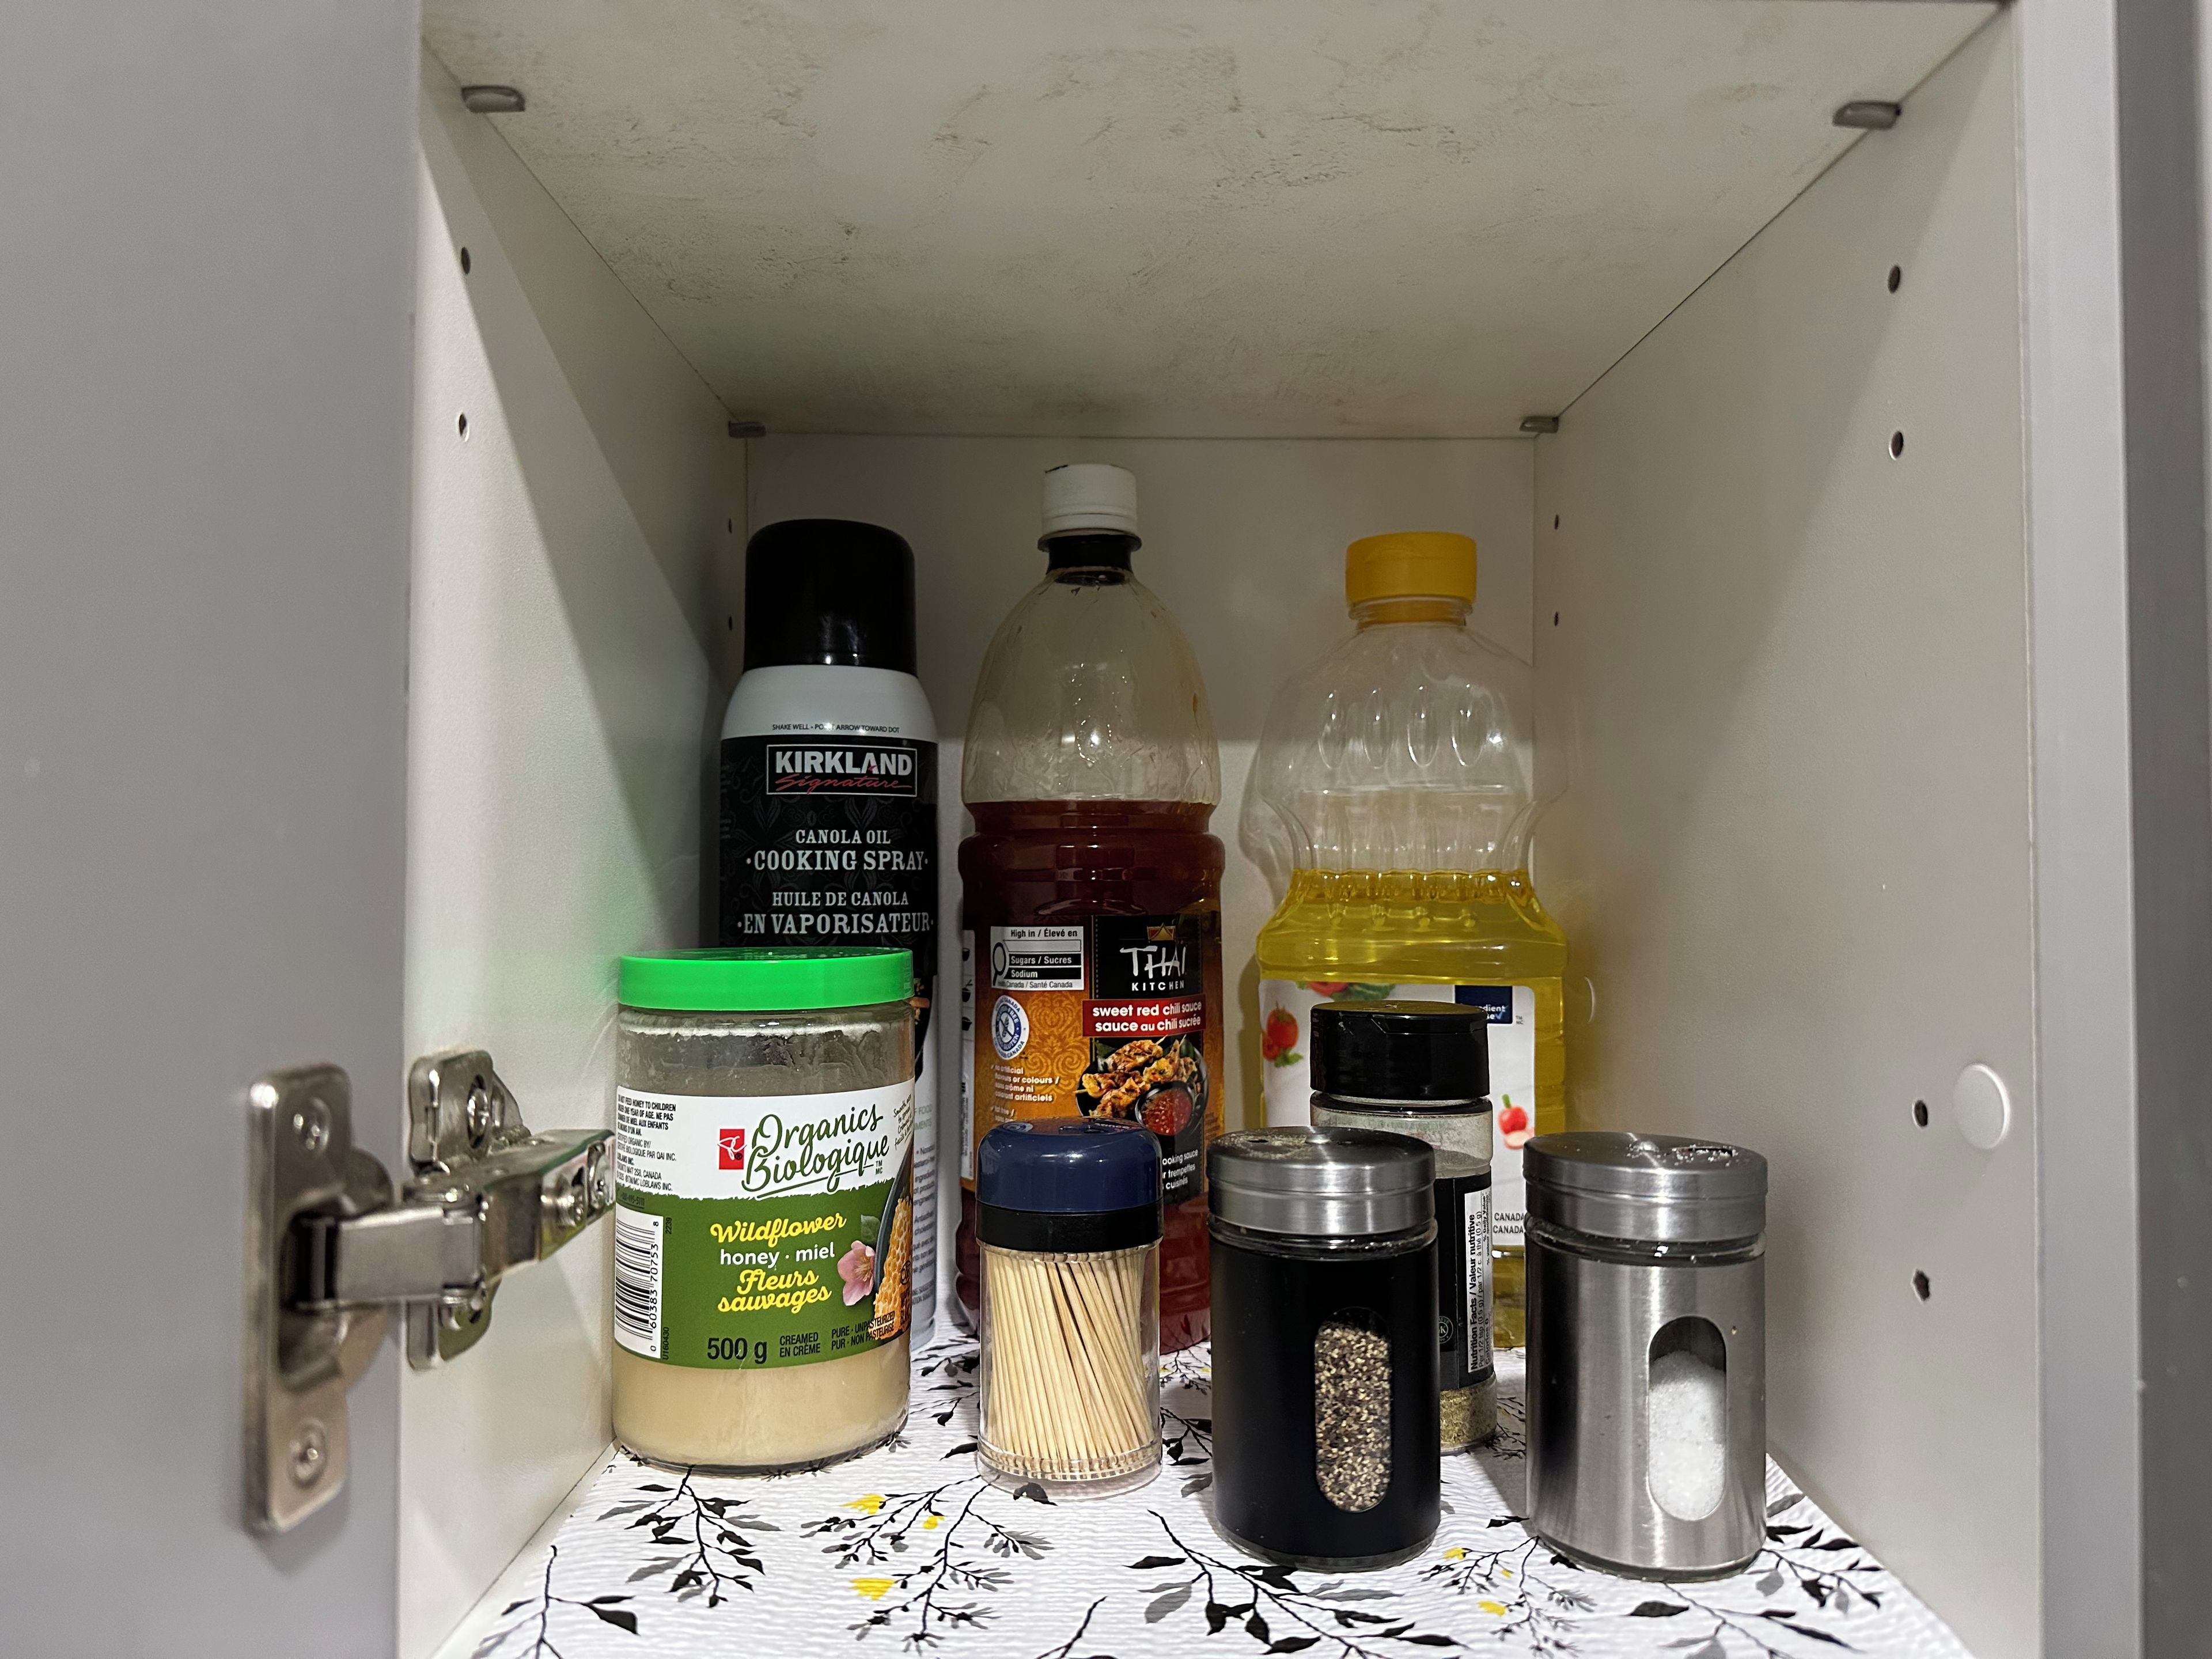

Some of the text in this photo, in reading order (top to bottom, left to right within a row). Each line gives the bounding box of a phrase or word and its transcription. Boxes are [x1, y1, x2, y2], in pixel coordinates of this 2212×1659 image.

[776, 751, 912, 776] KIRKLAND
[775, 774, 912, 795] Signature
[796, 830, 891, 844] CANOLA OIL
[754, 850, 925, 871] COOKING SPRAY
[772, 892, 909, 906] HUILE DE CANOLA
[743, 912, 930, 934] EN VAPORISATEUR
[1011, 929, 1026, 939] High
[1028, 929, 1036, 937] in
[1037, 929, 1042, 937] /
[1044, 928, 1066, 937] Élevé
[1011, 956, 1072, 966] Sugars / Sucres
[1119, 945, 1187, 979] THAI
[1011, 969, 1038, 978] Sodium
[1006, 980, 1025, 988] Canada
[1029, 980, 1048, 988] Santé
[1131, 980, 1185, 992] KITCHEN
[1092, 1001, 1202, 1017] sweet red chili sauce
[1095, 1013, 1202, 1032] sauce au chili sucrée
[1007, 1041, 1025, 1058] CANADA
[1021, 1077, 1053, 1085] colours
[632, 1099, 645, 1108] HONEY
[646, 1101, 651, 1109] TO
[652, 1101, 676, 1112] CHILDREN
[1014, 1094, 1053, 1102] artificiels
[639, 1109, 645, 1118] OF
[645, 1111, 655, 1119] AGE.
[656, 1112, 662, 1120] NE
[664, 1112, 673, 1121] PAS
[639, 1119, 647, 1127] AUX
[647, 1120, 669, 1130] ENFANTS
[752, 1104, 884, 1156] Organics
[628, 1136, 643, 1147] ORGANIC
[646, 1150, 656, 1158] PAR
[656, 1152, 665, 1160] QAI
[666, 1153, 677, 1161] INC.
[741, 1135, 890, 1192] Biologique
[1162, 1149, 1199, 1165] ooking sauce
[643, 1169, 662, 1180] CANADA
[876, 1167, 883, 1175] MC
[1168, 1163, 1196, 1179] trempettes
[640, 1179, 661, 1190] LOBLAWS
[662, 1183, 673, 1191] INC.
[1165, 1175, 1188, 1190] cuisinés
[1494, 1212, 1524, 1221] CANADA
[710, 1213, 847, 1248] Wildflower
[1468, 1214, 1476, 1255] nutritive
[1493, 1225, 1524, 1234] CANADA
[650, 1244, 659, 1282] 70753
[720, 1242, 835, 1269] honey miel
[737, 1268, 820, 1295] Fleurs
[718, 1286, 832, 1314] sauvages
[649, 1289, 657, 1329] 60383
[831, 1310, 895, 1339] PURE UNPASTEURIZED
[779, 1332, 819, 1346] CREAMED
[831, 1338, 846, 1350] PUR
[851, 1334, 865, 1346] NON
[707, 1337, 767, 1365] 500 g
[779, 1342, 821, 1358] EN CRÈME
[1470, 1326, 1478, 1370] Nutrition
